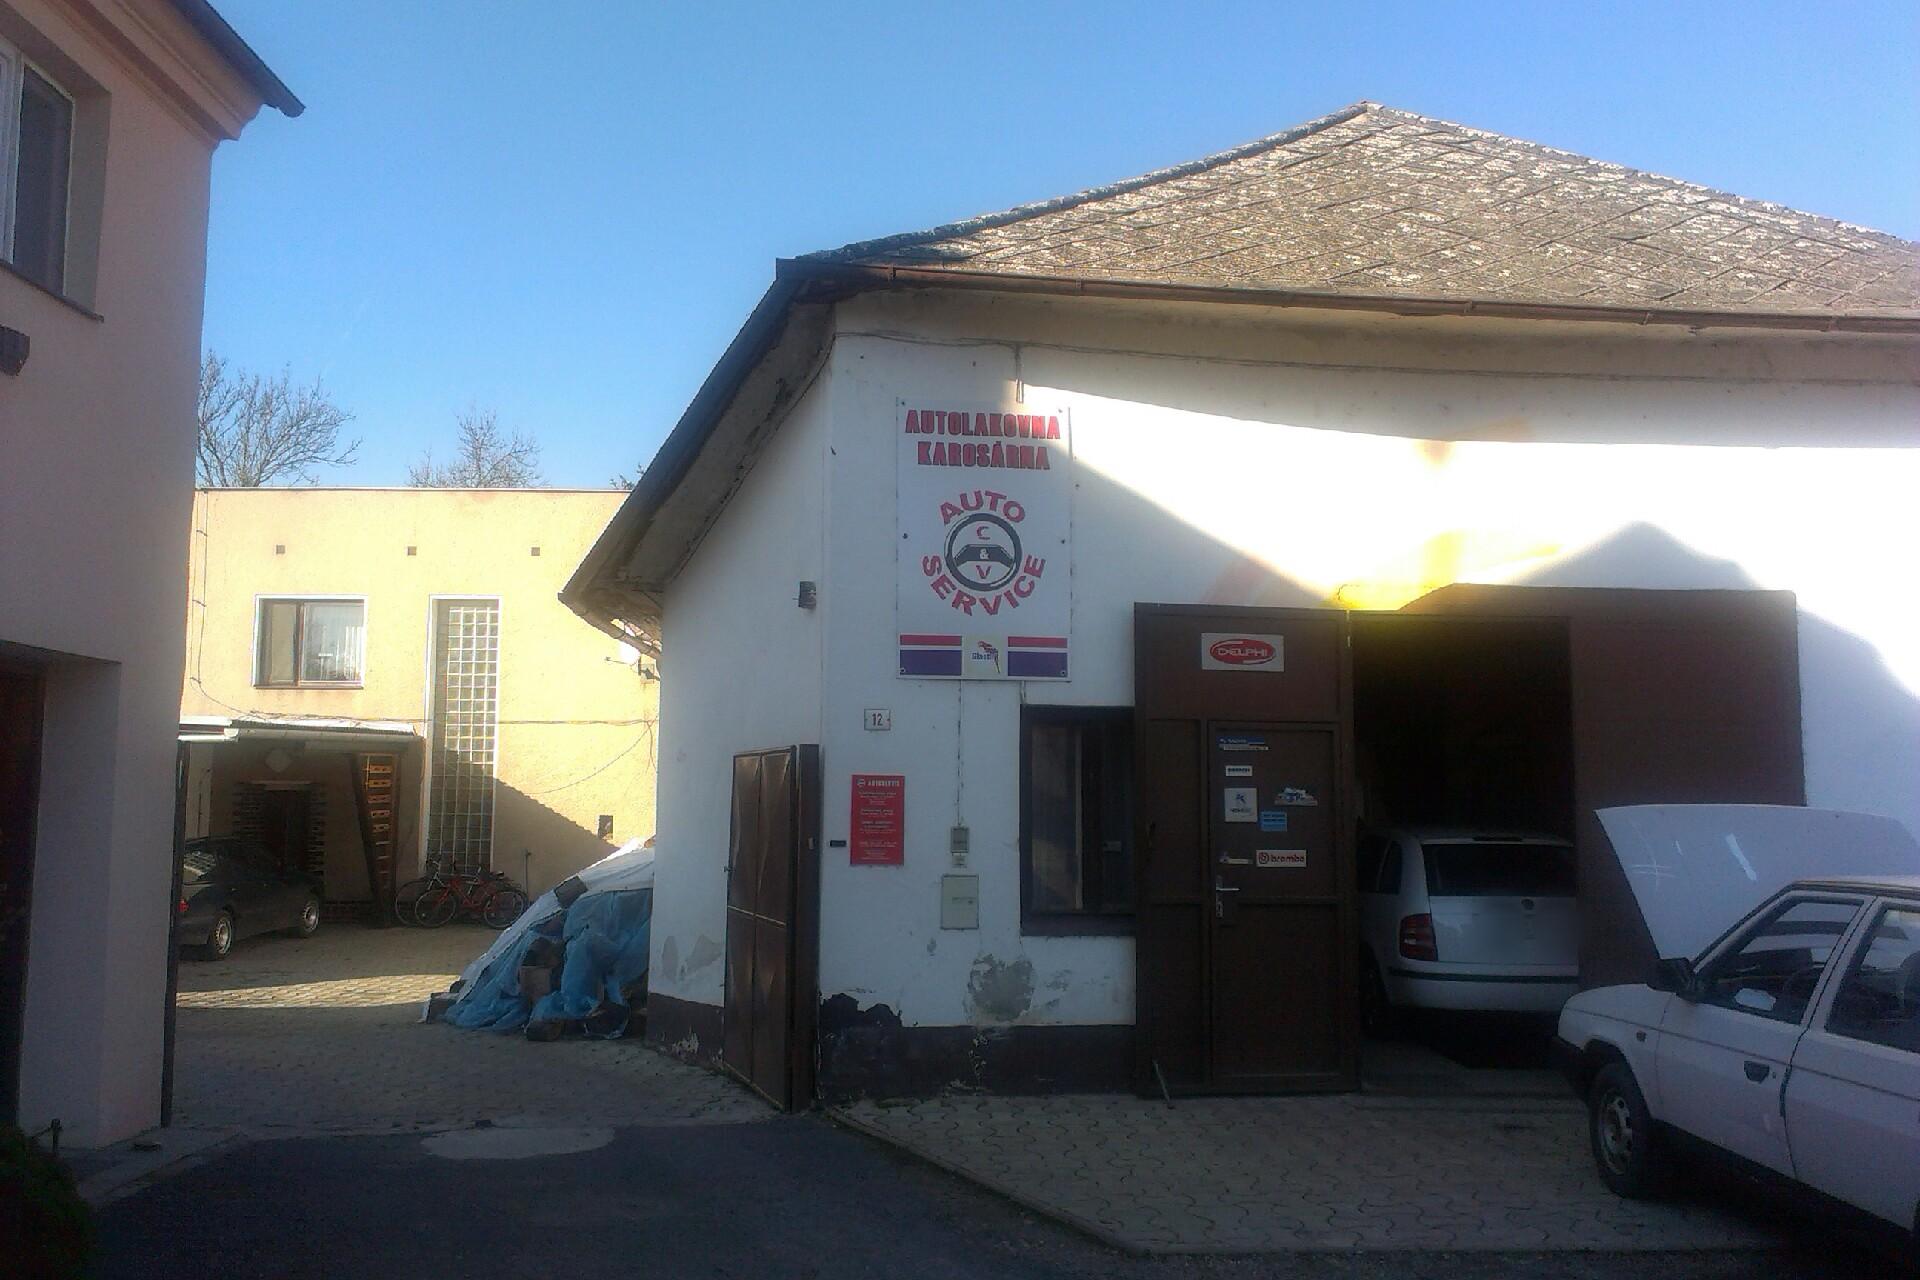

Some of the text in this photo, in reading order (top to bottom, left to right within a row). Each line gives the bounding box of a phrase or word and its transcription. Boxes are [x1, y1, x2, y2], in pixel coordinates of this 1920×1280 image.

[905, 409, 1061, 439] AUTOLAKOVNA
[917, 440, 1050, 470] KAROSÁRNA
[939, 490, 1026, 526] AUTO
[976, 525, 991, 540] C
[979, 548, 989, 560] &
[976, 565, 991, 579] V
[922, 555, 1046, 616] SERVICE
[1216, 647, 1268, 657] DELPHI
[872, 713, 883, 727] 12
[1270, 853, 1305, 863] brembo
